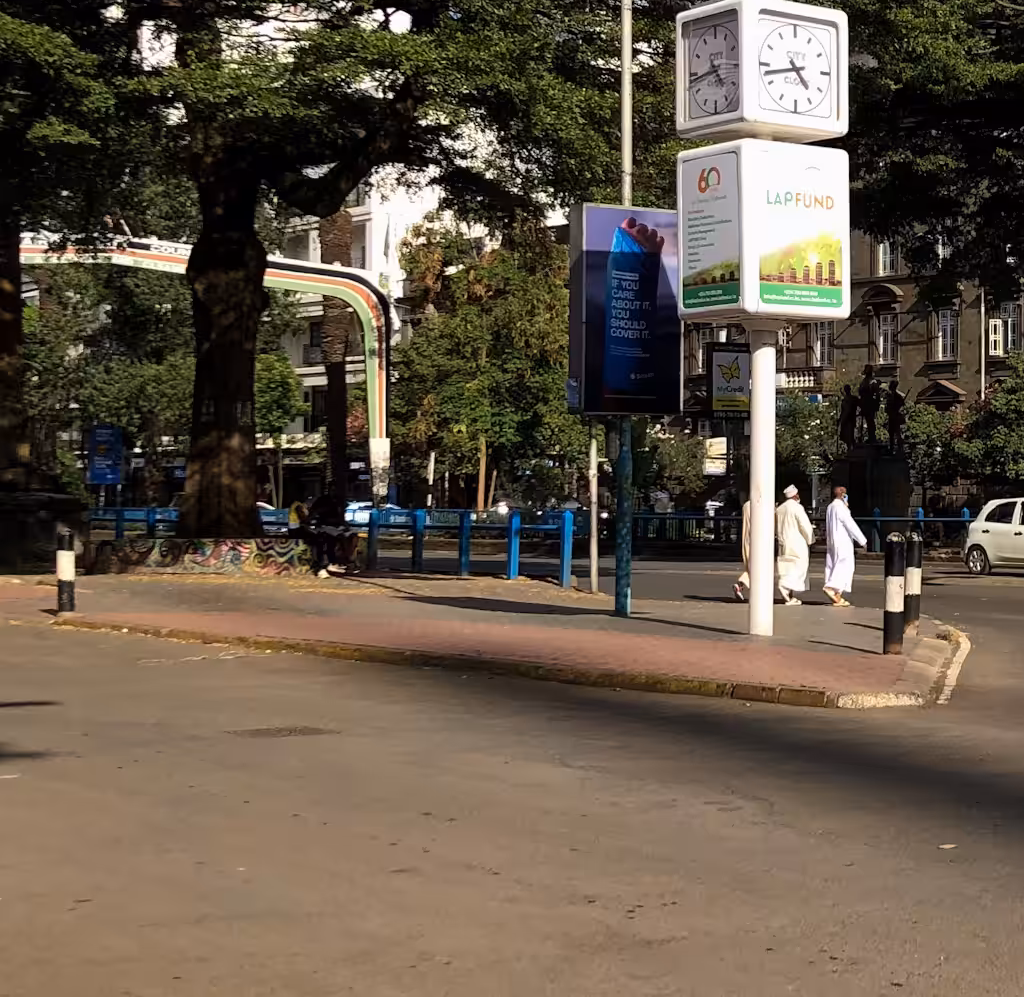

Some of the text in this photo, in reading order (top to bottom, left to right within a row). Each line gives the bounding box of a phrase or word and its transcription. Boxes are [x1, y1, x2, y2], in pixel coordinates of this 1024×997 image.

[786, 50, 806, 62] CITY
[766, 189, 835, 211] LAPFUND
[621, 280, 640, 290] YOU
[611, 288, 636, 300] CARE
[611, 298, 641, 310] ABOUT
[611, 308, 630, 319] YOU
[610, 317, 647, 330] SHOULD
[610, 327, 640, 339] COVER
